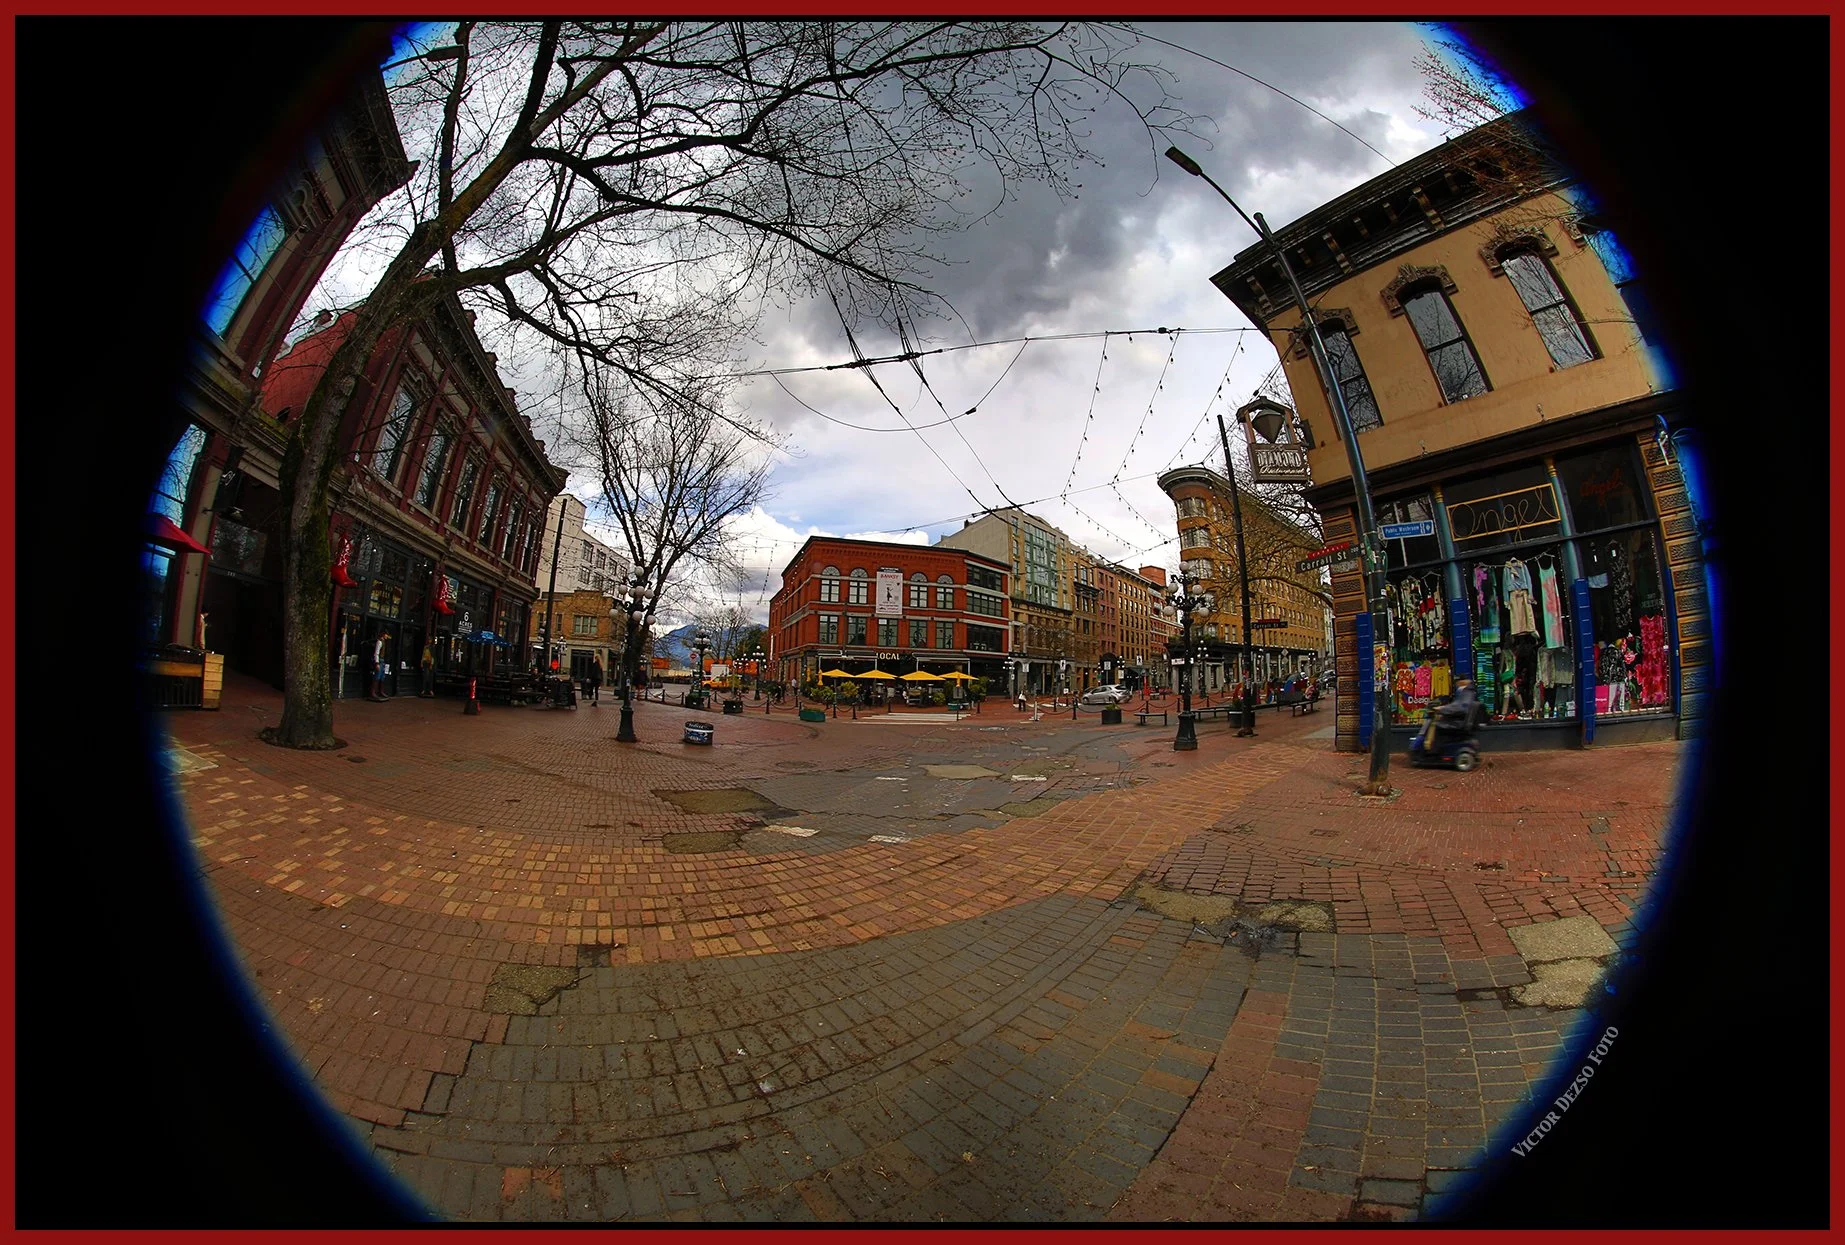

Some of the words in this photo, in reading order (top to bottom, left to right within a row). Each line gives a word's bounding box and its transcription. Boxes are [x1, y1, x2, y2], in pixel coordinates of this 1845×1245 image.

[1256, 452, 1301, 467] DIAMOND
[1300, 554, 1333, 571] Carrall
[1337, 550, 1347, 561] St
[464, 611, 470, 621] 6
